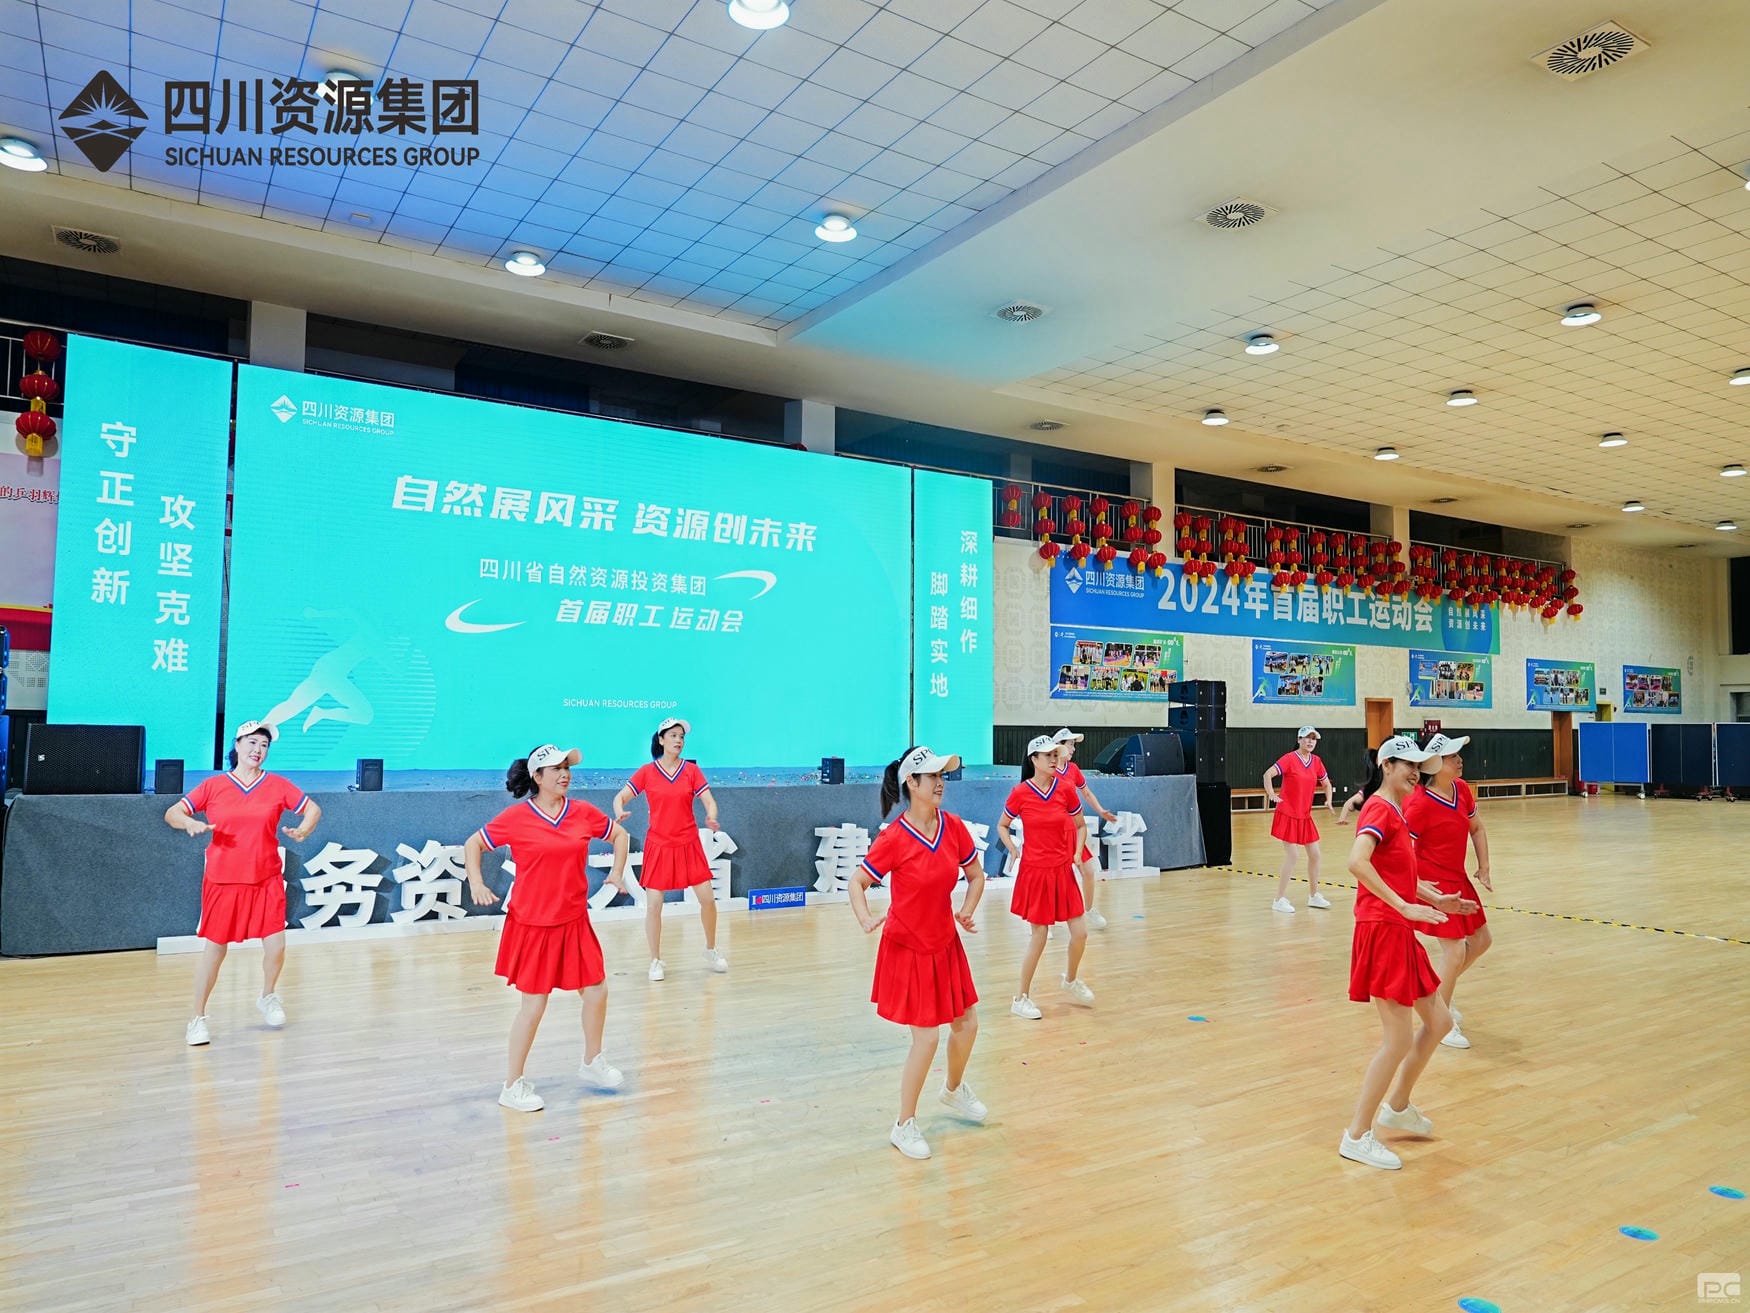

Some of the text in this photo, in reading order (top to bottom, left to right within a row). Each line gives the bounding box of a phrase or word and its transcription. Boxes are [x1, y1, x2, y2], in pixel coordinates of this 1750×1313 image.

[302, 400, 395, 428] 四川资源集团
[302, 418, 332, 428] SICHUAN
[333, 422, 371, 434] RESOURCES
[91, 421, 137, 605] 守正创新
[392, 475, 817, 552] 自然展风采 资源创未来
[151, 494, 196, 673] 攻坚克难
[479, 557, 707, 597] 四川省自然资源投资集团
[960, 530, 978, 654] 深耕细作
[1086, 570, 1145, 590] 四川资源集团
[556, 599, 745, 633] 首届职工运动会
[1158, 568, 1433, 633] 2024年首届职工运动会
[930, 572, 949, 698] 脚踏实地
[563, 698, 677, 709] SICHUAN RESOURCES GROUP
[762, 891, 803, 904] 四川资源集团
